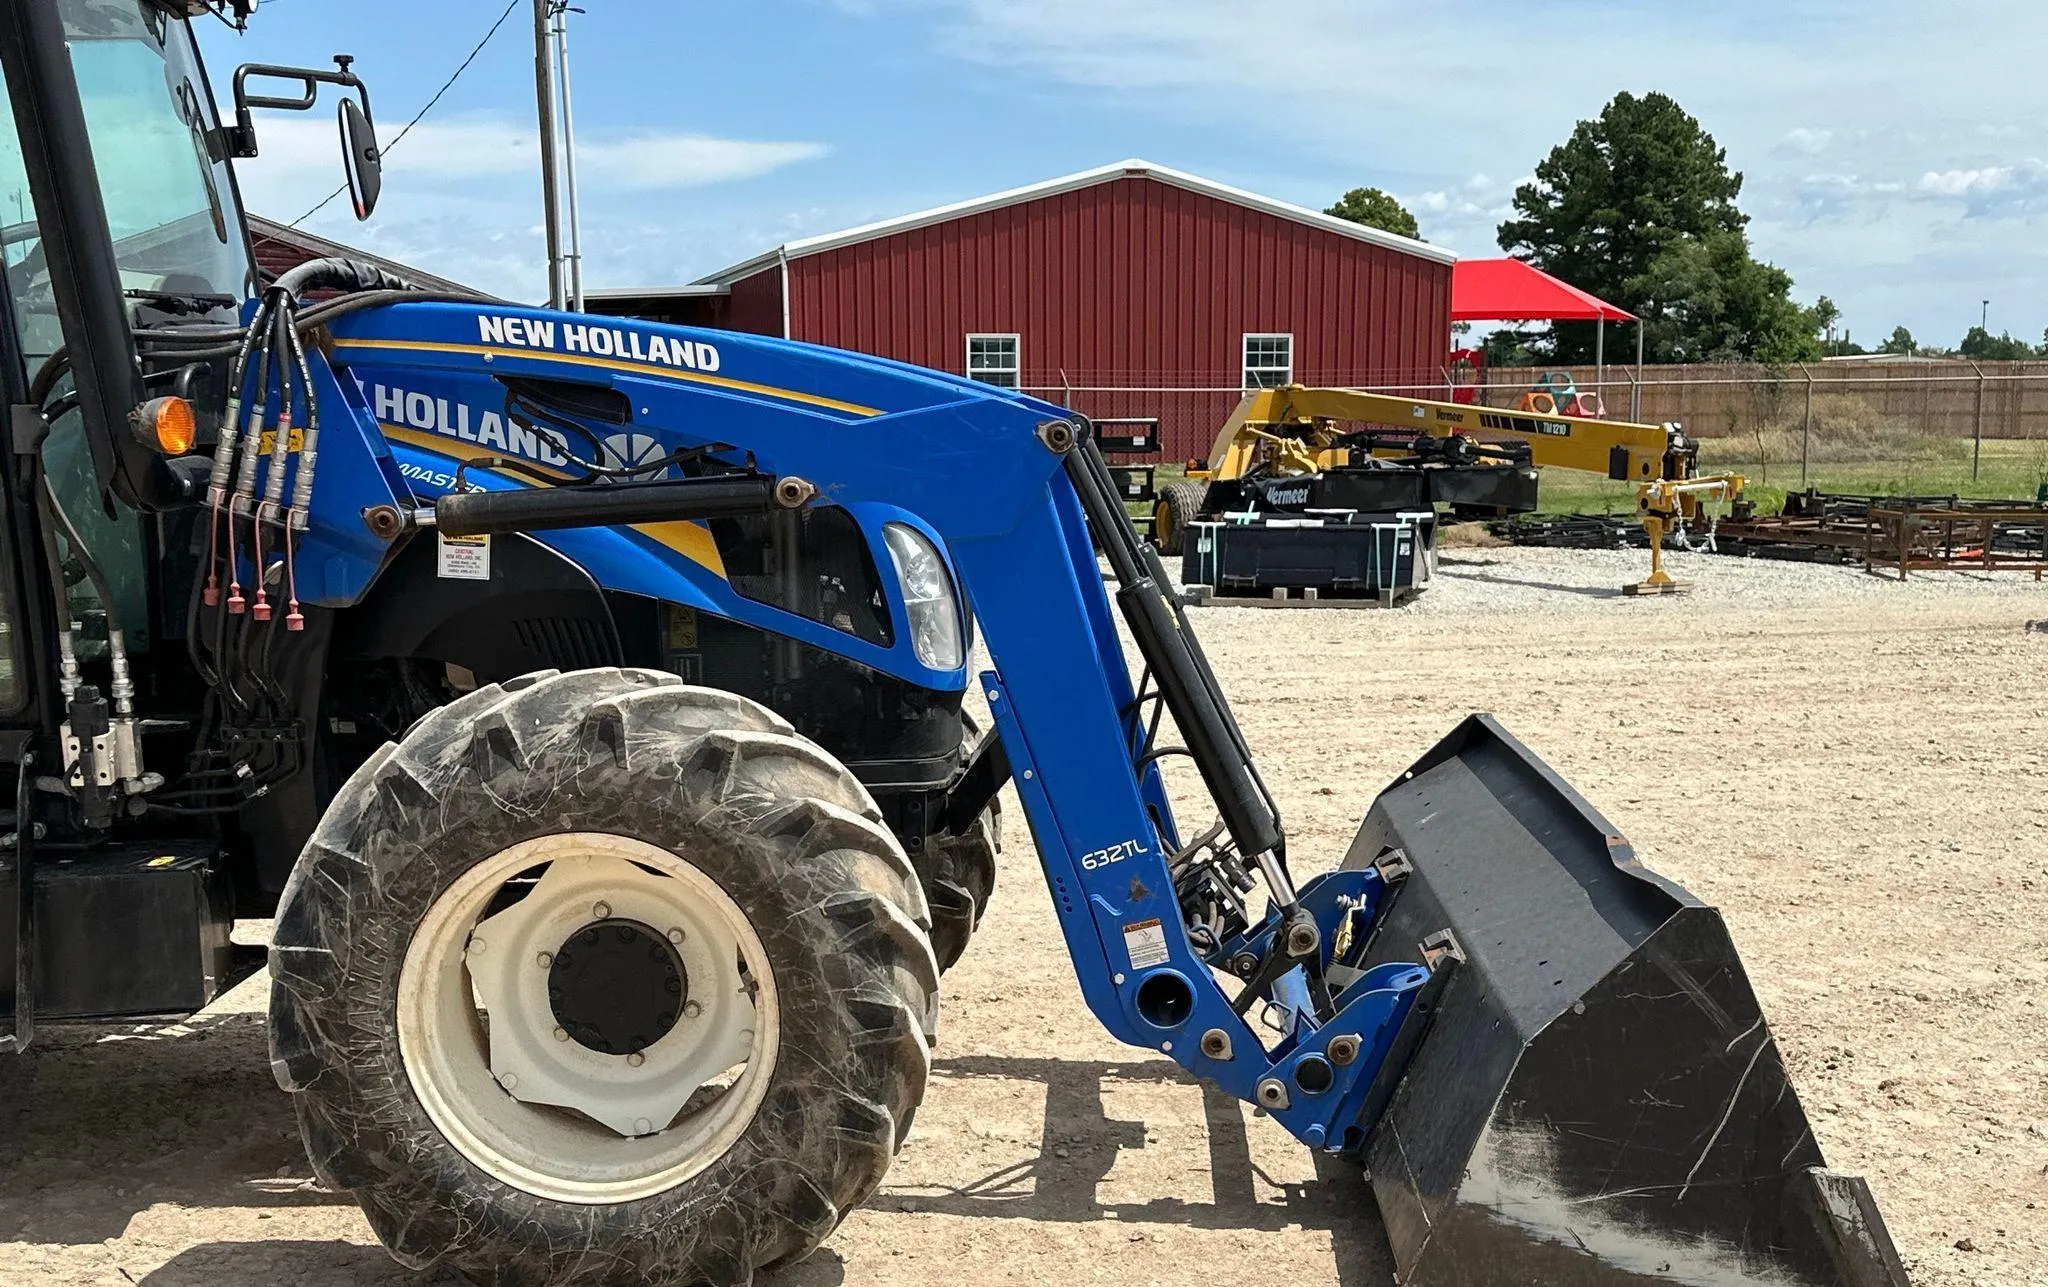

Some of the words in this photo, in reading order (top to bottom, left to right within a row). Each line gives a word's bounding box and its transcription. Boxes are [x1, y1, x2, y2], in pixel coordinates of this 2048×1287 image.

[478, 315, 554, 349] NEW
[563, 323, 720, 372] HOLLAND
[374, 383, 569, 467] HOLLAND
[1436, 408, 1464, 422] Vermeer
[1266, 486, 1309, 505] Vermeer
[1082, 839, 1148, 870] 632TL
[347, 918, 411, 1124] ALLIANCE
